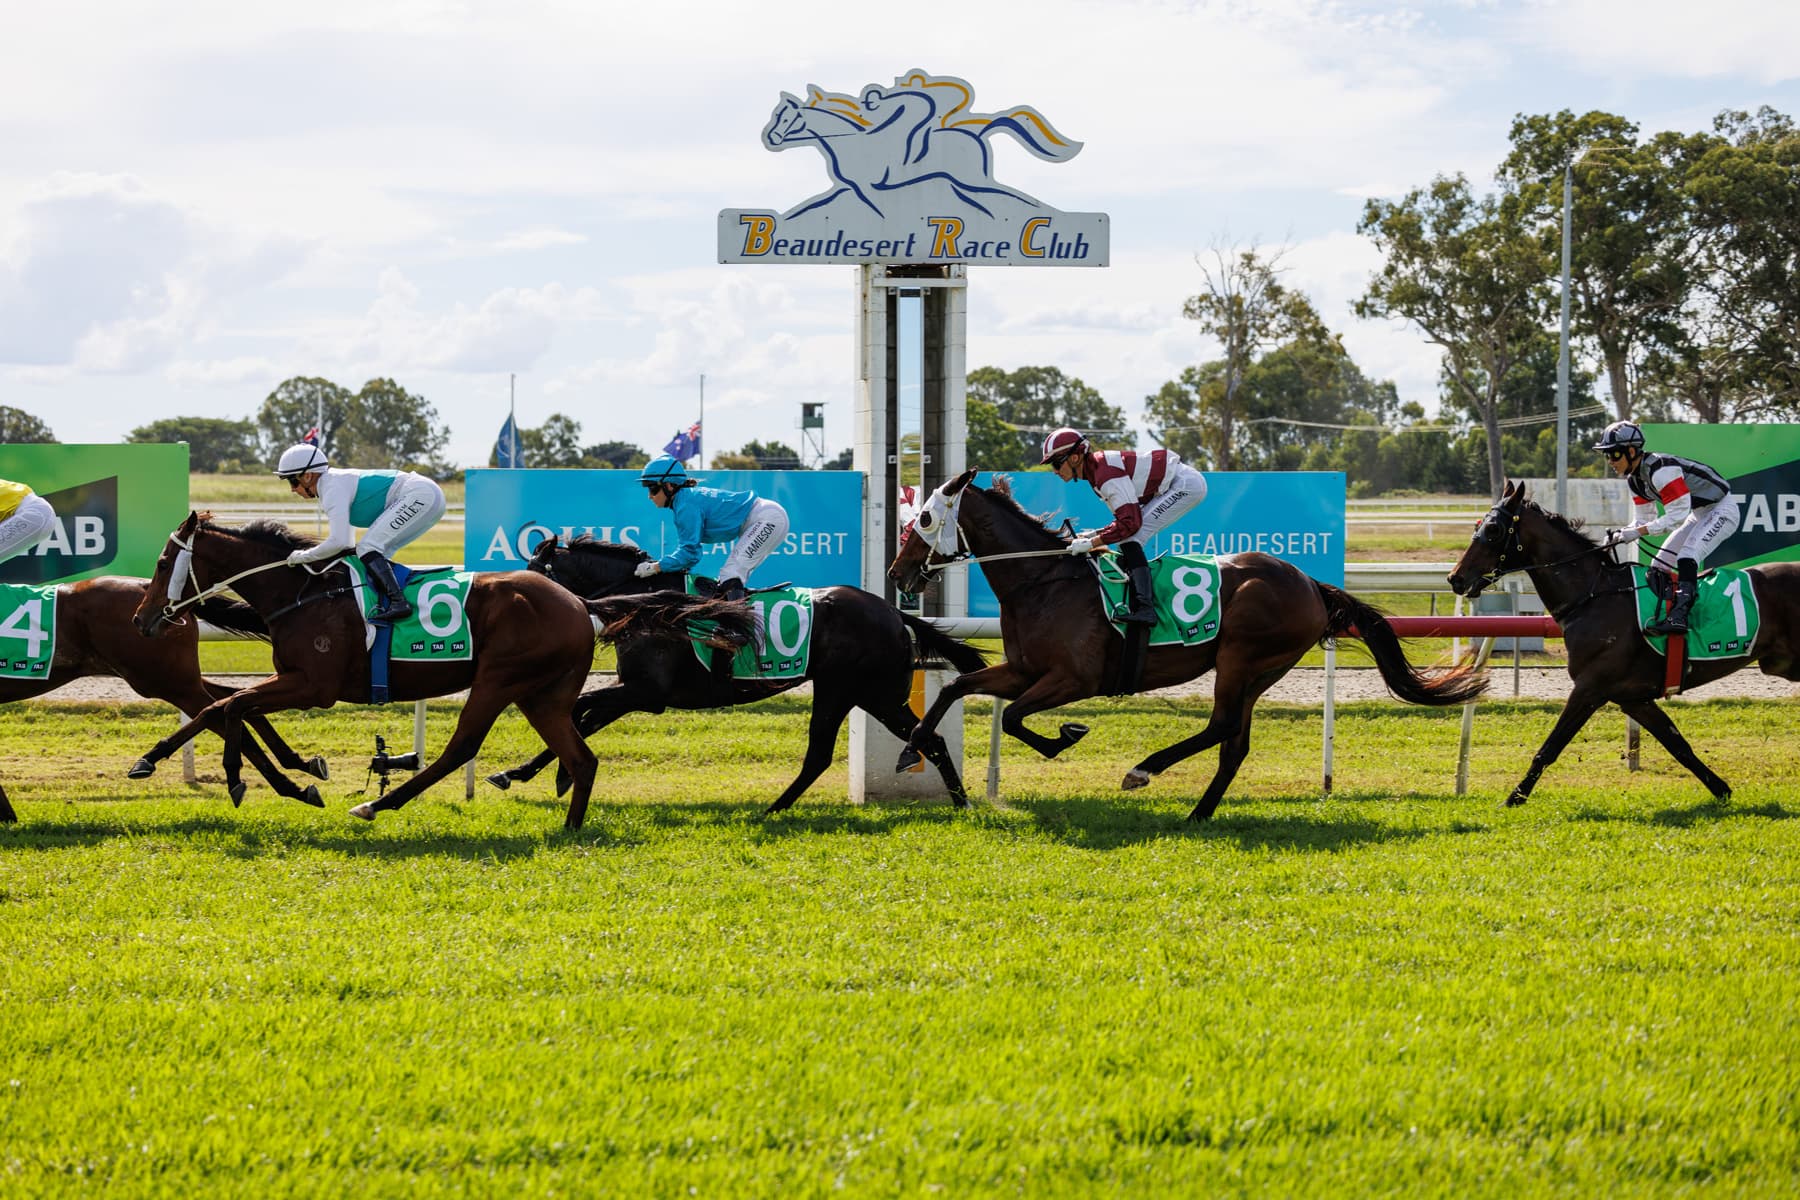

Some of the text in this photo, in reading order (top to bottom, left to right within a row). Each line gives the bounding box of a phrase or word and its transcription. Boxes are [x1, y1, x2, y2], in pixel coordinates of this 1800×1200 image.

[739, 214, 1090, 260] Beaudesert Race Club
[17, 516, 106, 556] AB
[745, 522, 776, 559] JAMIESON
[1171, 532, 1333, 555] BEAUDESERT
[417, 579, 463, 638] 6
[1171, 566, 1214, 624] 8
[1723, 577, 1748, 638] 1
[0, 599, 49, 659] 4
[751, 600, 809, 657] 10
